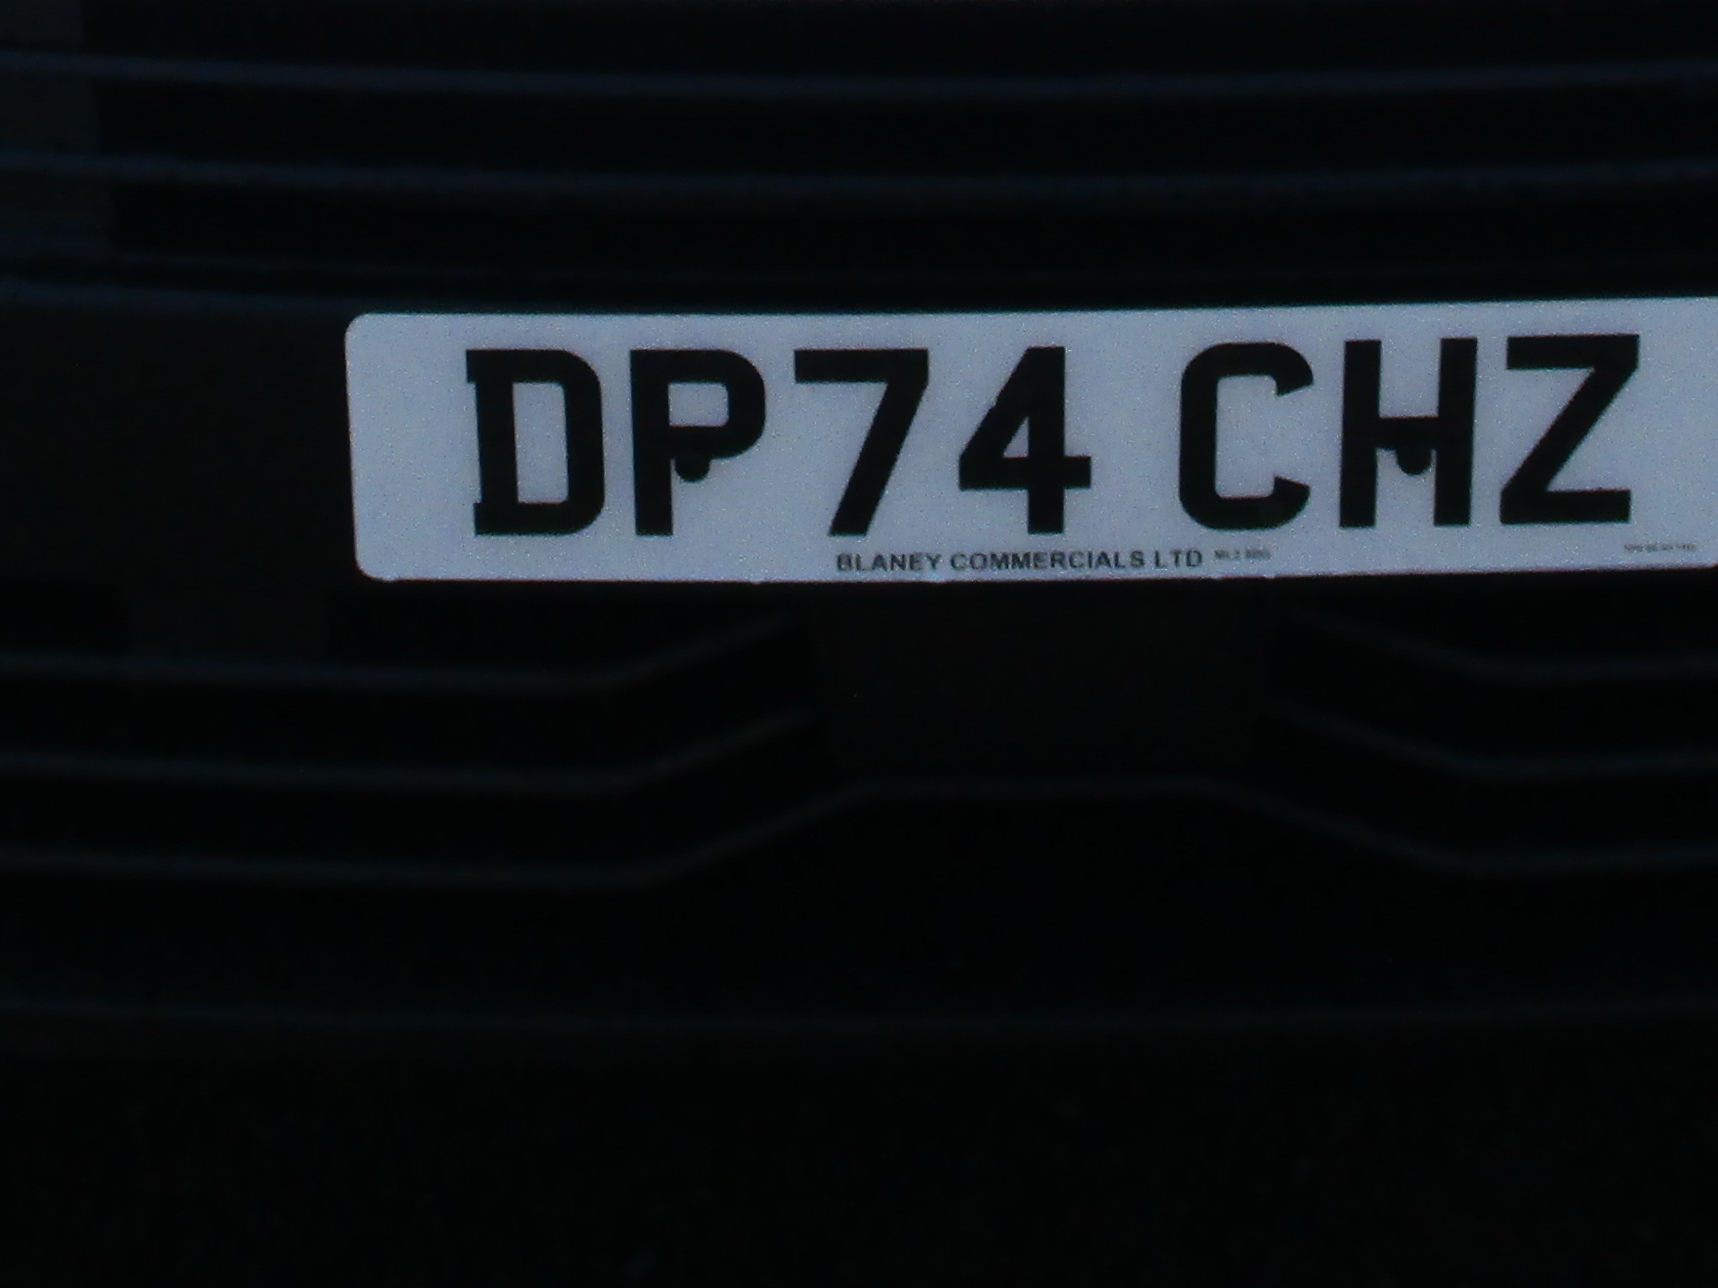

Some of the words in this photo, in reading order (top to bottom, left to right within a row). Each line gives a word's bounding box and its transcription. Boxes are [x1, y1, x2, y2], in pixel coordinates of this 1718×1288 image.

[466, 346, 1092, 536] DP74
[1179, 334, 1640, 530] CHZ
[836, 553, 941, 572] BLANEY
[950, 550, 1145, 571] COMMERCIALS
[1155, 549, 1203, 568] LTD
